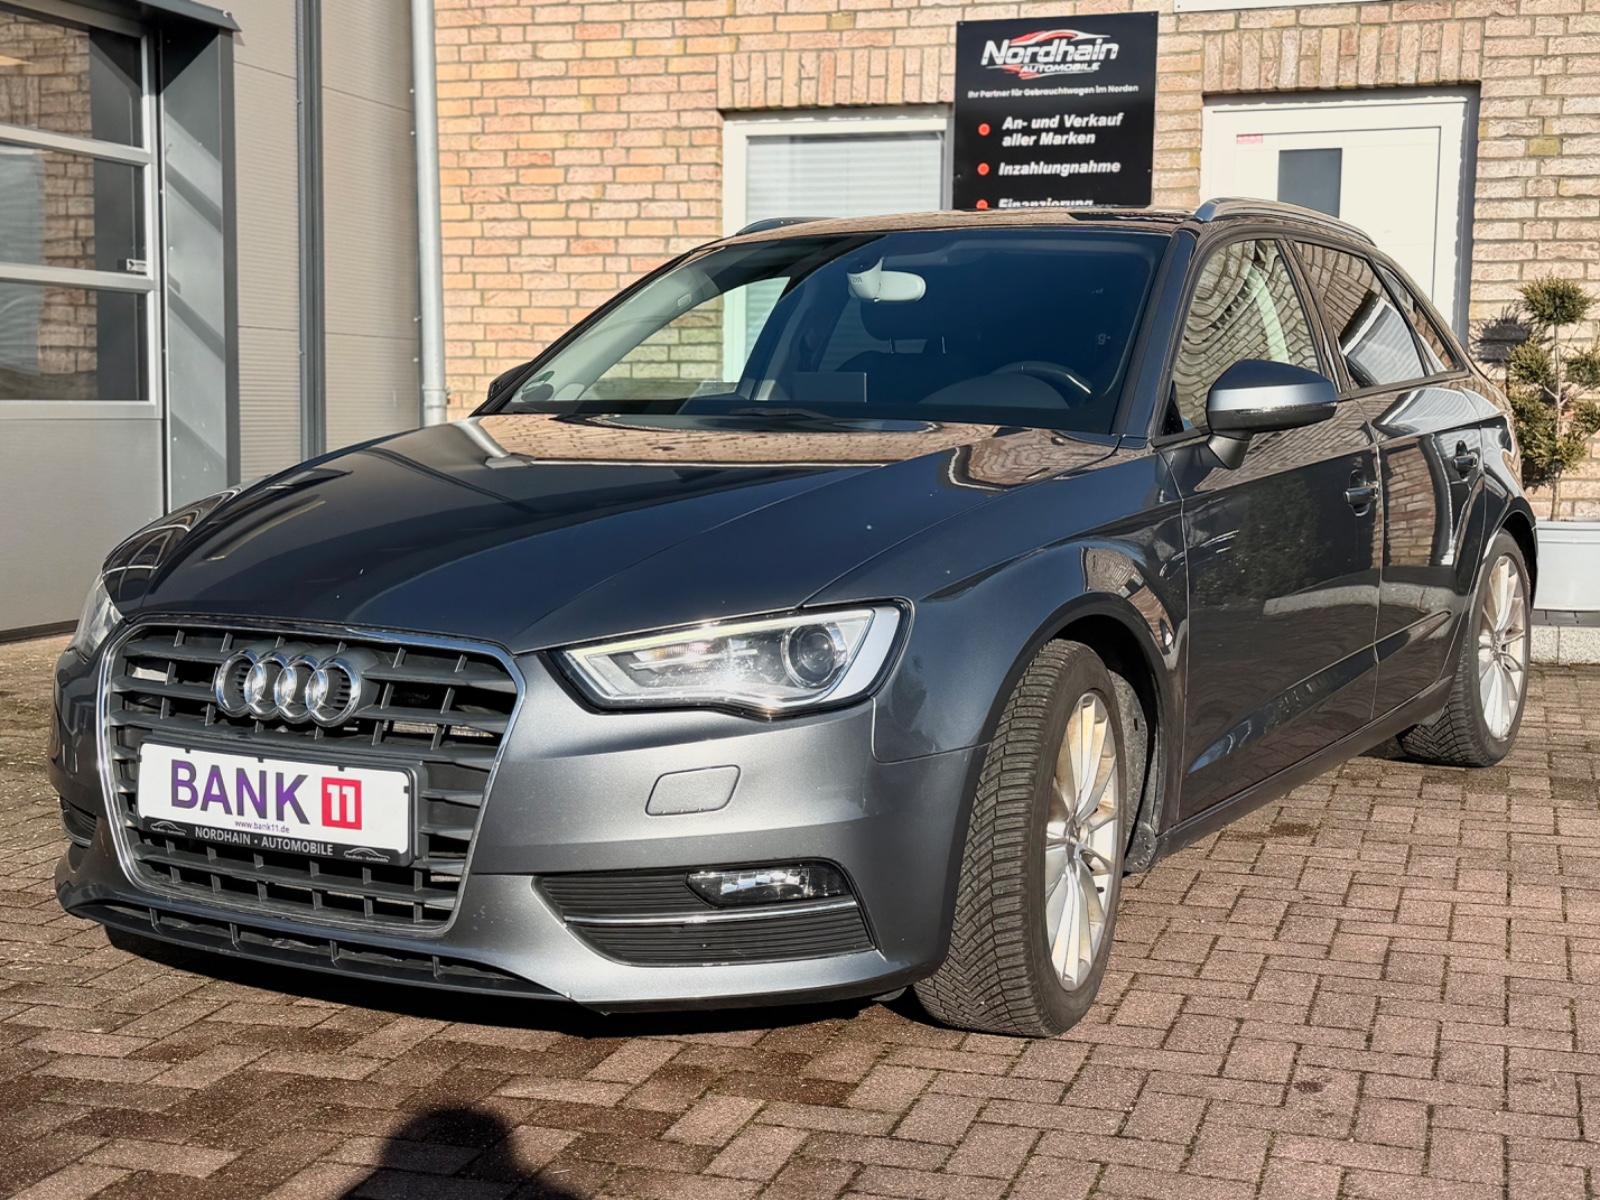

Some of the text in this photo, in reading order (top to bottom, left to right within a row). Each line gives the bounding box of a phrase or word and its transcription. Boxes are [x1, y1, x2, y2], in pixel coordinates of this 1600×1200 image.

[981, 39, 1119, 65] Nordhain
[1021, 62, 1101, 73] AUTOMOBILE
[968, 84, 1138, 98] Ihr Partner für Gebrauchtwagen im Norden
[1002, 112, 1124, 130] An- und Verkauf
[1002, 131, 1096, 147] aller Marken
[998, 160, 1121, 177] Inzahlungnahme
[171, 759, 356, 825] BANK 11
[234, 820, 290, 834] www.bank11.de
[195, 826, 251, 845] NORDHAIN
[261, 836, 334, 856] AUTOMOBILE
